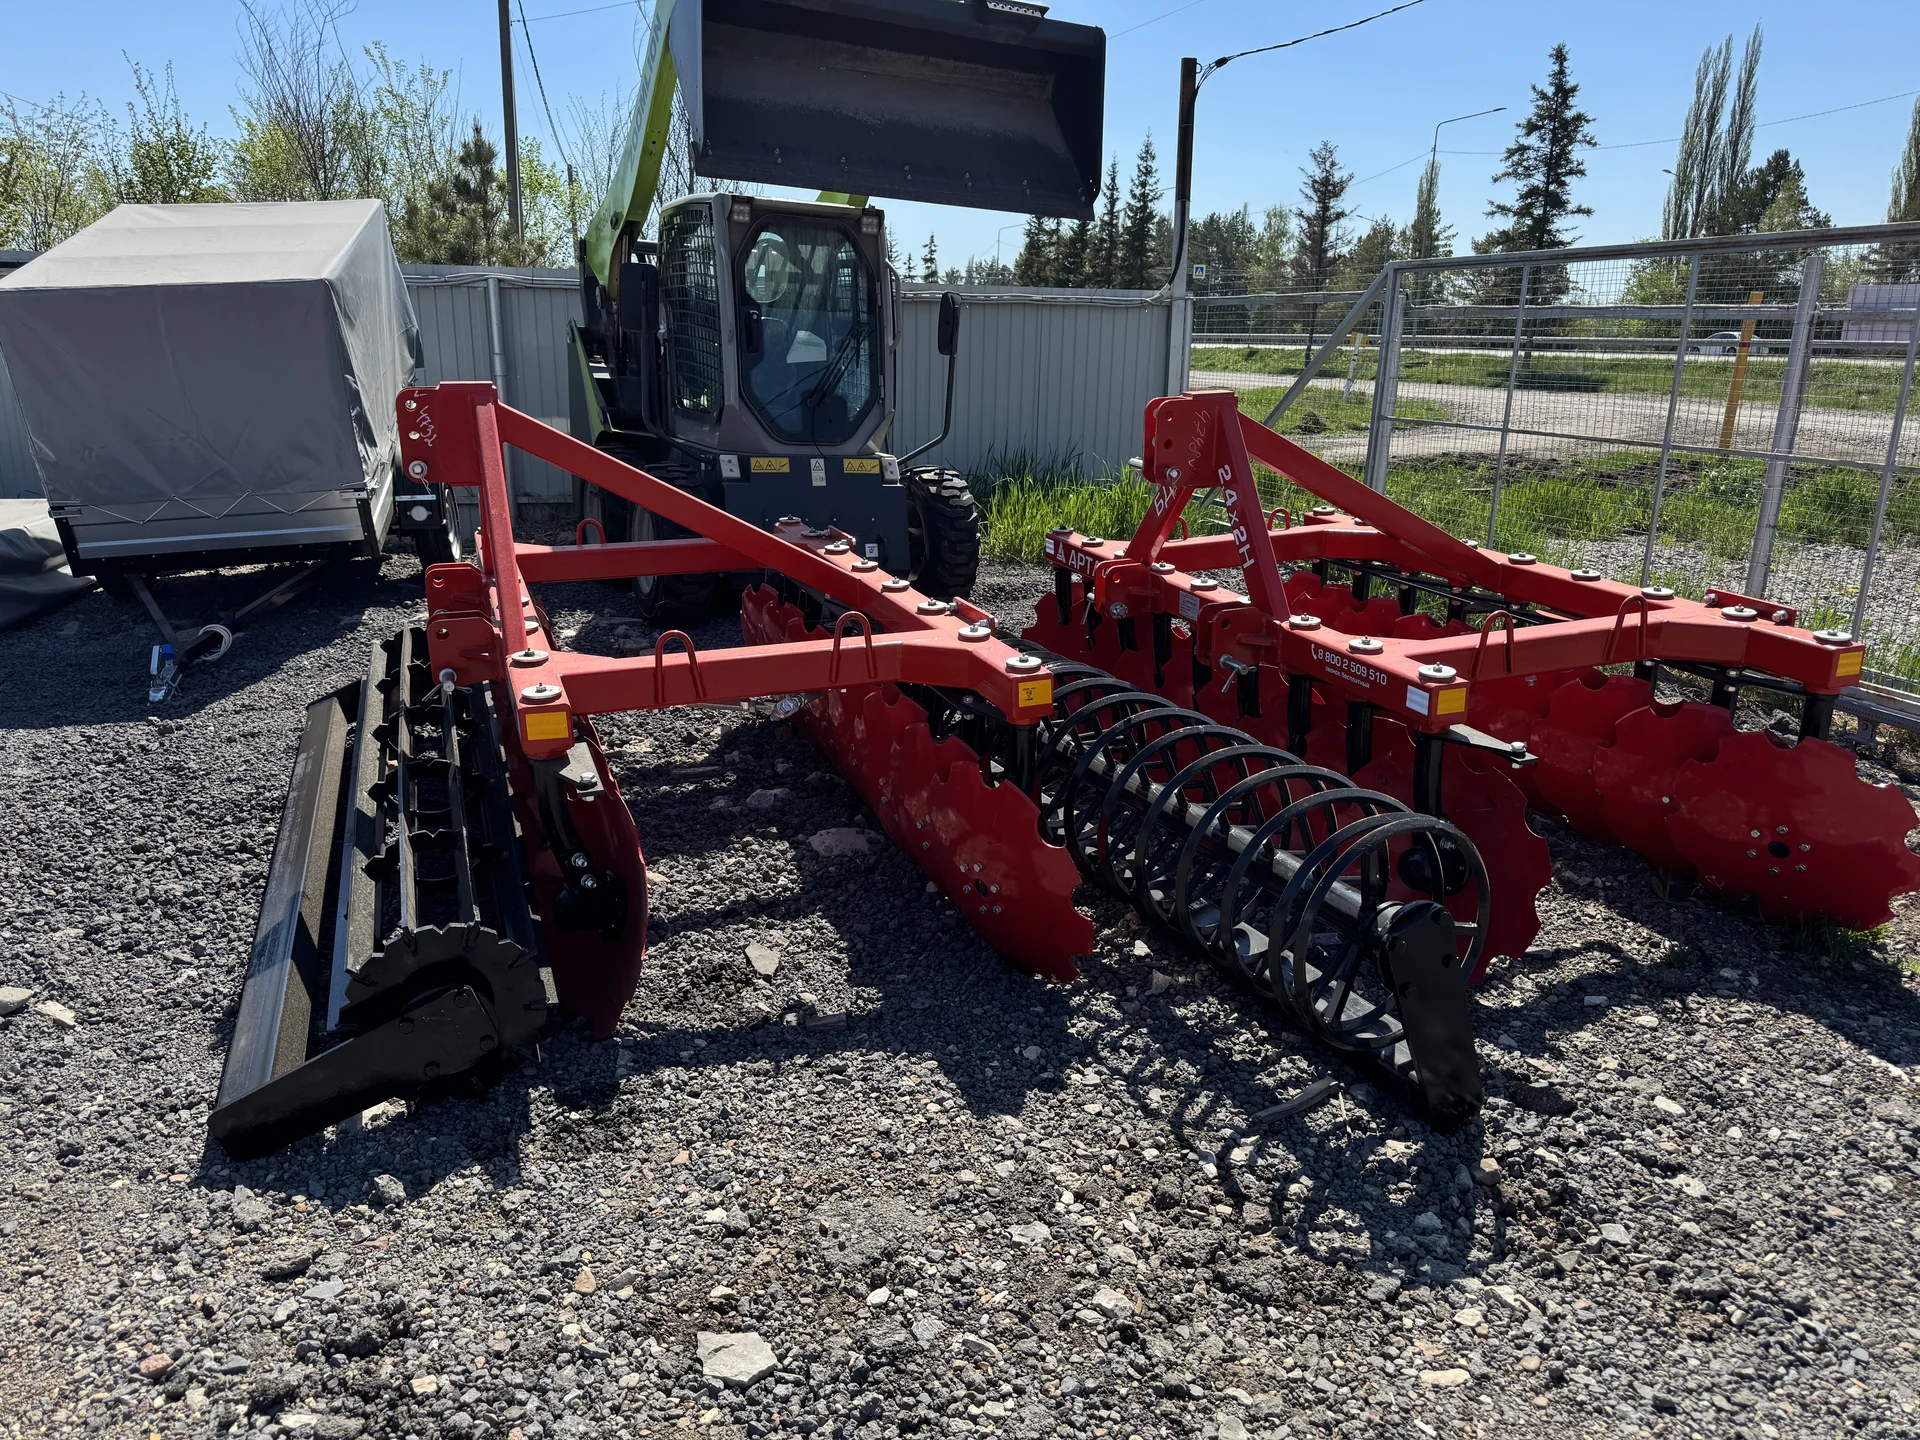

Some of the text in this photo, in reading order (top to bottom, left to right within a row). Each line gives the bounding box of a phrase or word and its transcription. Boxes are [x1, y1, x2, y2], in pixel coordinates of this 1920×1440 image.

[628, 12, 662, 172] ZOOMLION
[1069, 549, 1108, 578] АРТ
[1318, 649, 1387, 685] 8 800 2 509 510
